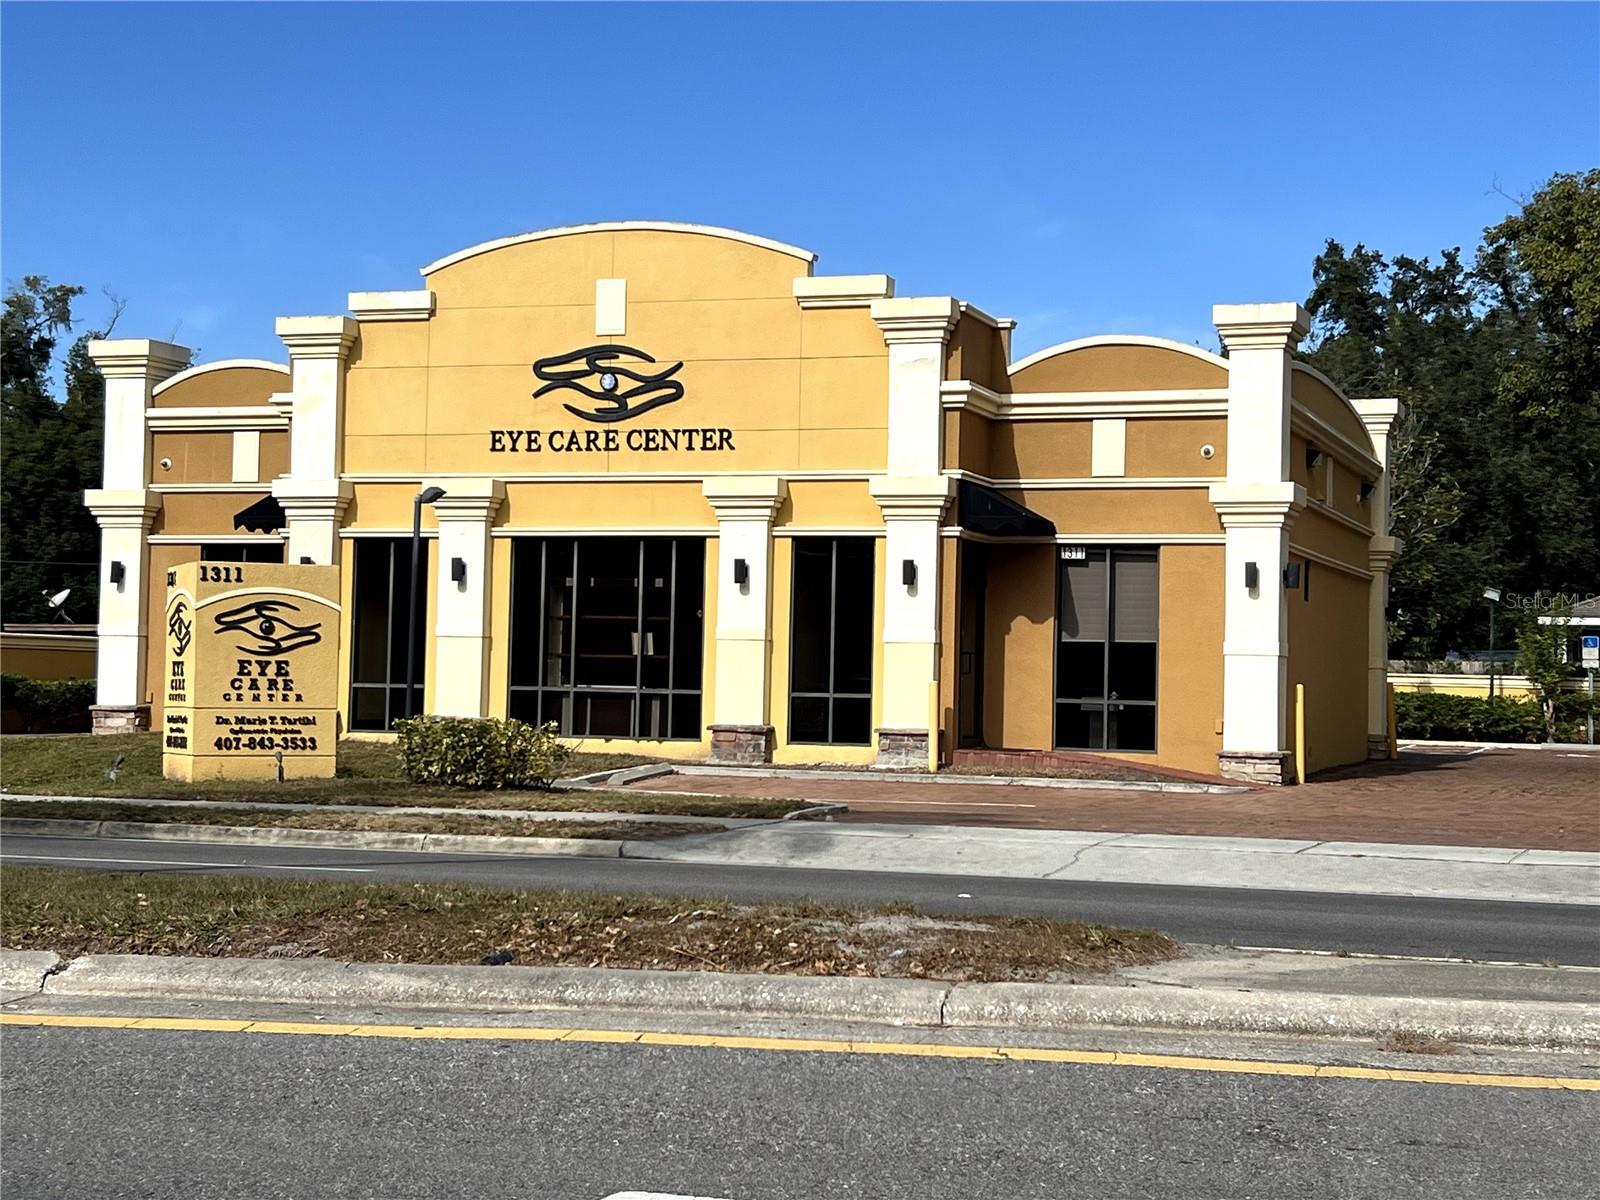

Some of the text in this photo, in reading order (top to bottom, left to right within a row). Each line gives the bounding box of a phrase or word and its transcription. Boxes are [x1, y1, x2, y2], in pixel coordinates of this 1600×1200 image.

[490, 428, 736, 452] EYE CARE CENTER
[200, 566, 244, 583] 1311
[237, 659, 290, 677] EYE
[230, 678, 294, 691] CARE
[222, 693, 304, 702] CENTER
[215, 716, 232, 725] Dr.
[214, 737, 317, 750] 407-843-3533
